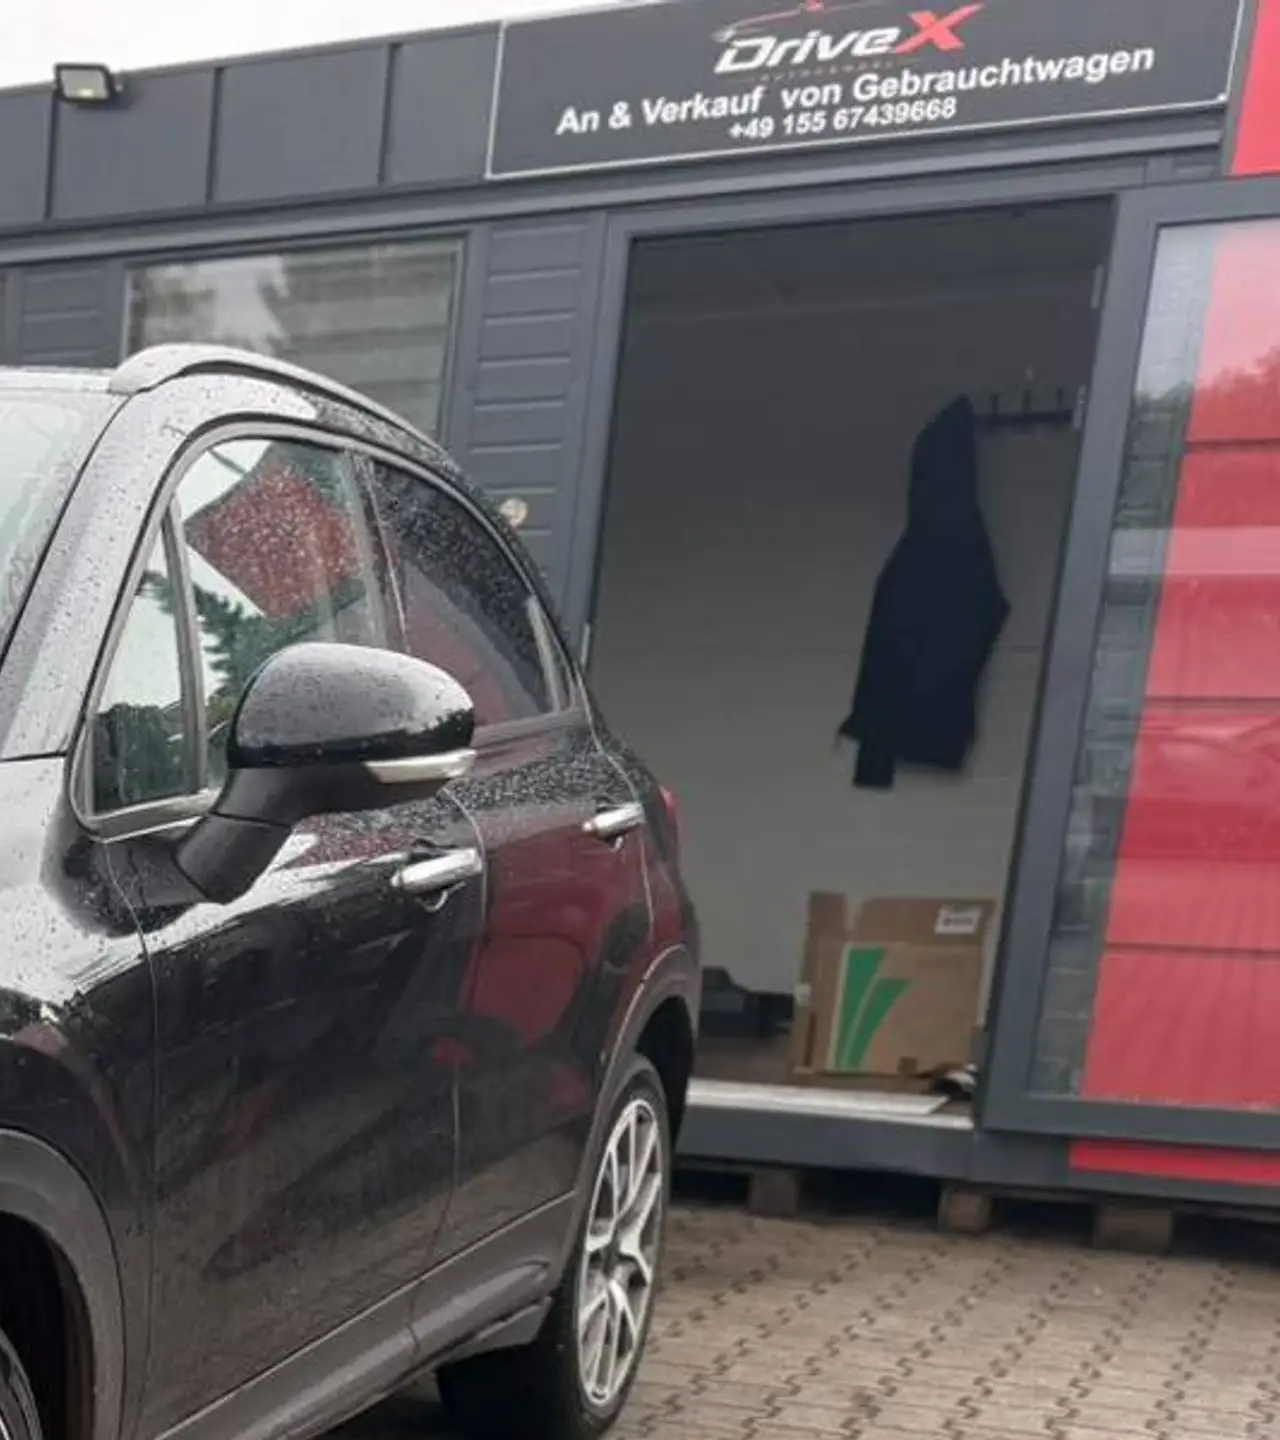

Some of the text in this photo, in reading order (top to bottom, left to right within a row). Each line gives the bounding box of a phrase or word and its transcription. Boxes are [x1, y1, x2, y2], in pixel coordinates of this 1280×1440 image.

[555, 105, 600, 136] An
[608, 101, 632, 129] &
[642, 86, 767, 126] Verkauf
[781, 82, 842, 109] von
[853, 47, 1156, 102] Gebrauchtwagen
[728, 97, 958, 140] +49 155 67439668
